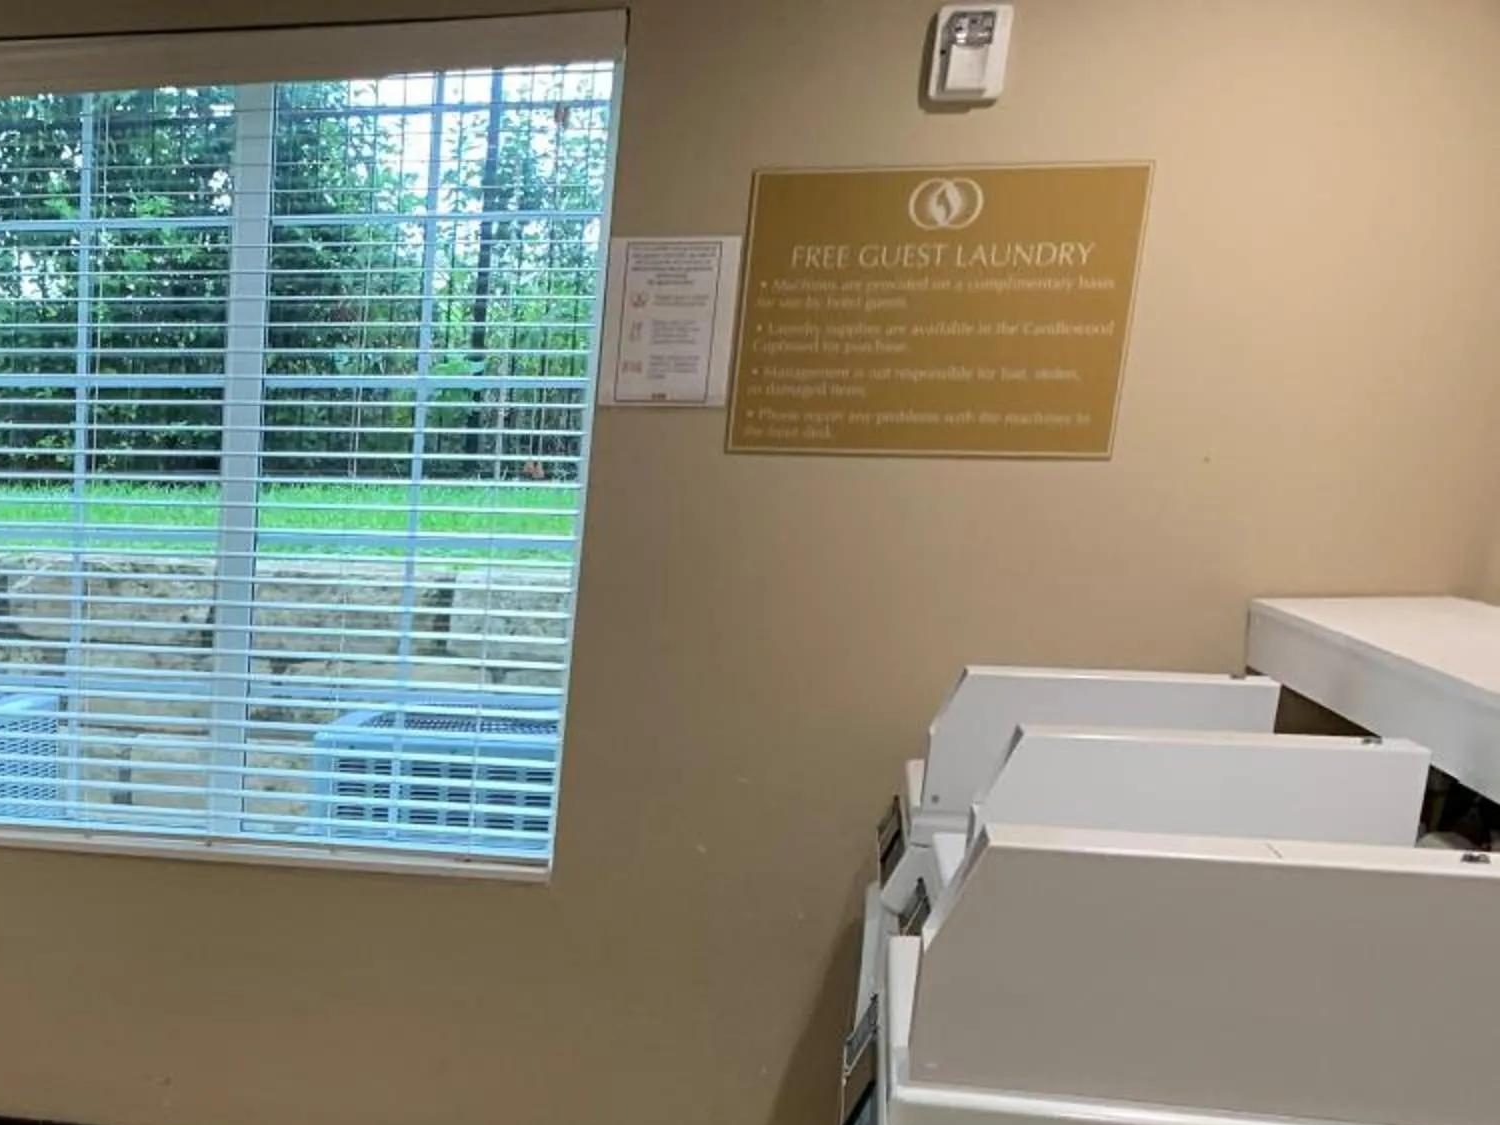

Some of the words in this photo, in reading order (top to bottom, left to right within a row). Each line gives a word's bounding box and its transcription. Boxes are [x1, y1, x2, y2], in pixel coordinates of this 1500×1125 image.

[791, 244, 852, 269] FREE
[859, 243, 949, 269] GUEST
[956, 241, 1098, 268] LAUNDRY
